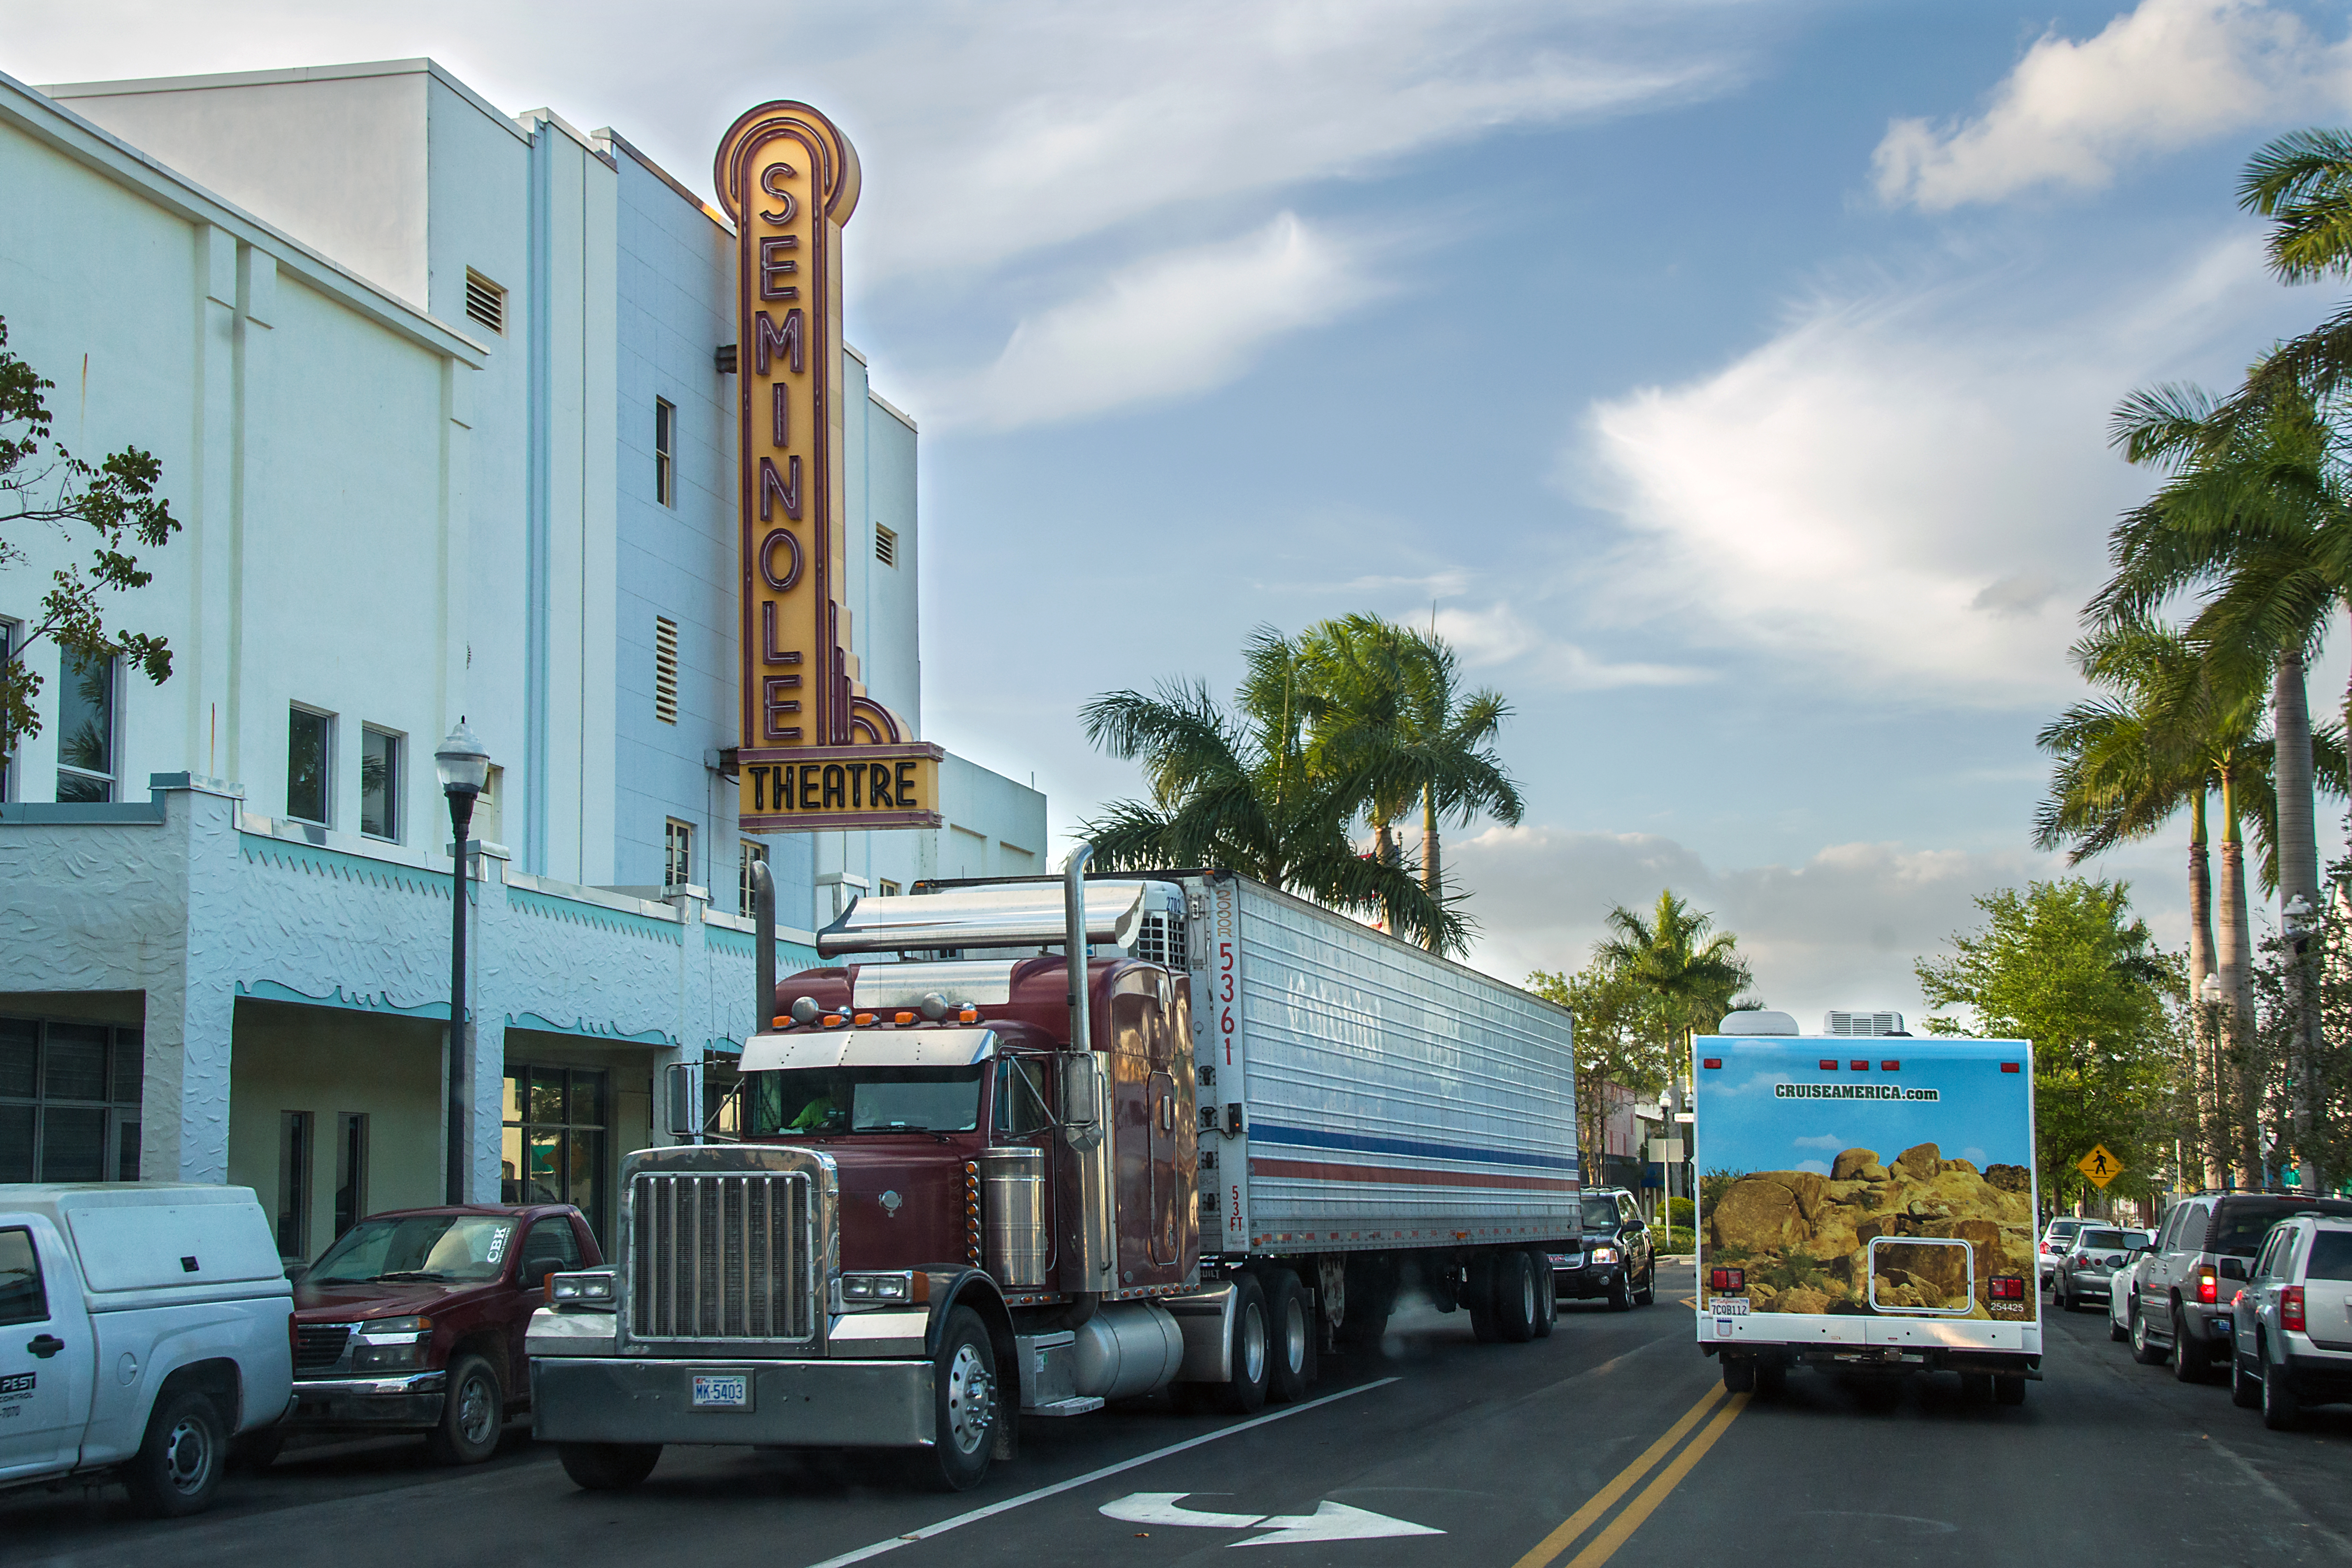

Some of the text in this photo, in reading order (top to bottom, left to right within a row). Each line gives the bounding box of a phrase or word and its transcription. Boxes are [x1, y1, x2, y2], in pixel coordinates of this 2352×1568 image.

[755, 162, 804, 740] SEMINOLE
[748, 762, 917, 810] THEATRE
[1167, 897, 1181, 913] 2702
[1220, 943, 1235, 1066] 53361
[1775, 1084, 1938, 1100] CRUISEAMERICA.com
[487, 1227, 507, 1263] CBK
[1200, 1270, 1219, 1279] UILT
[1711, 1305, 1747, 1315] 7CQB112
[1991, 1303, 2024, 1312] 254425
[3, 1375, 34, 1391] PEST
[696, 1384, 743, 1399] MK-5403
